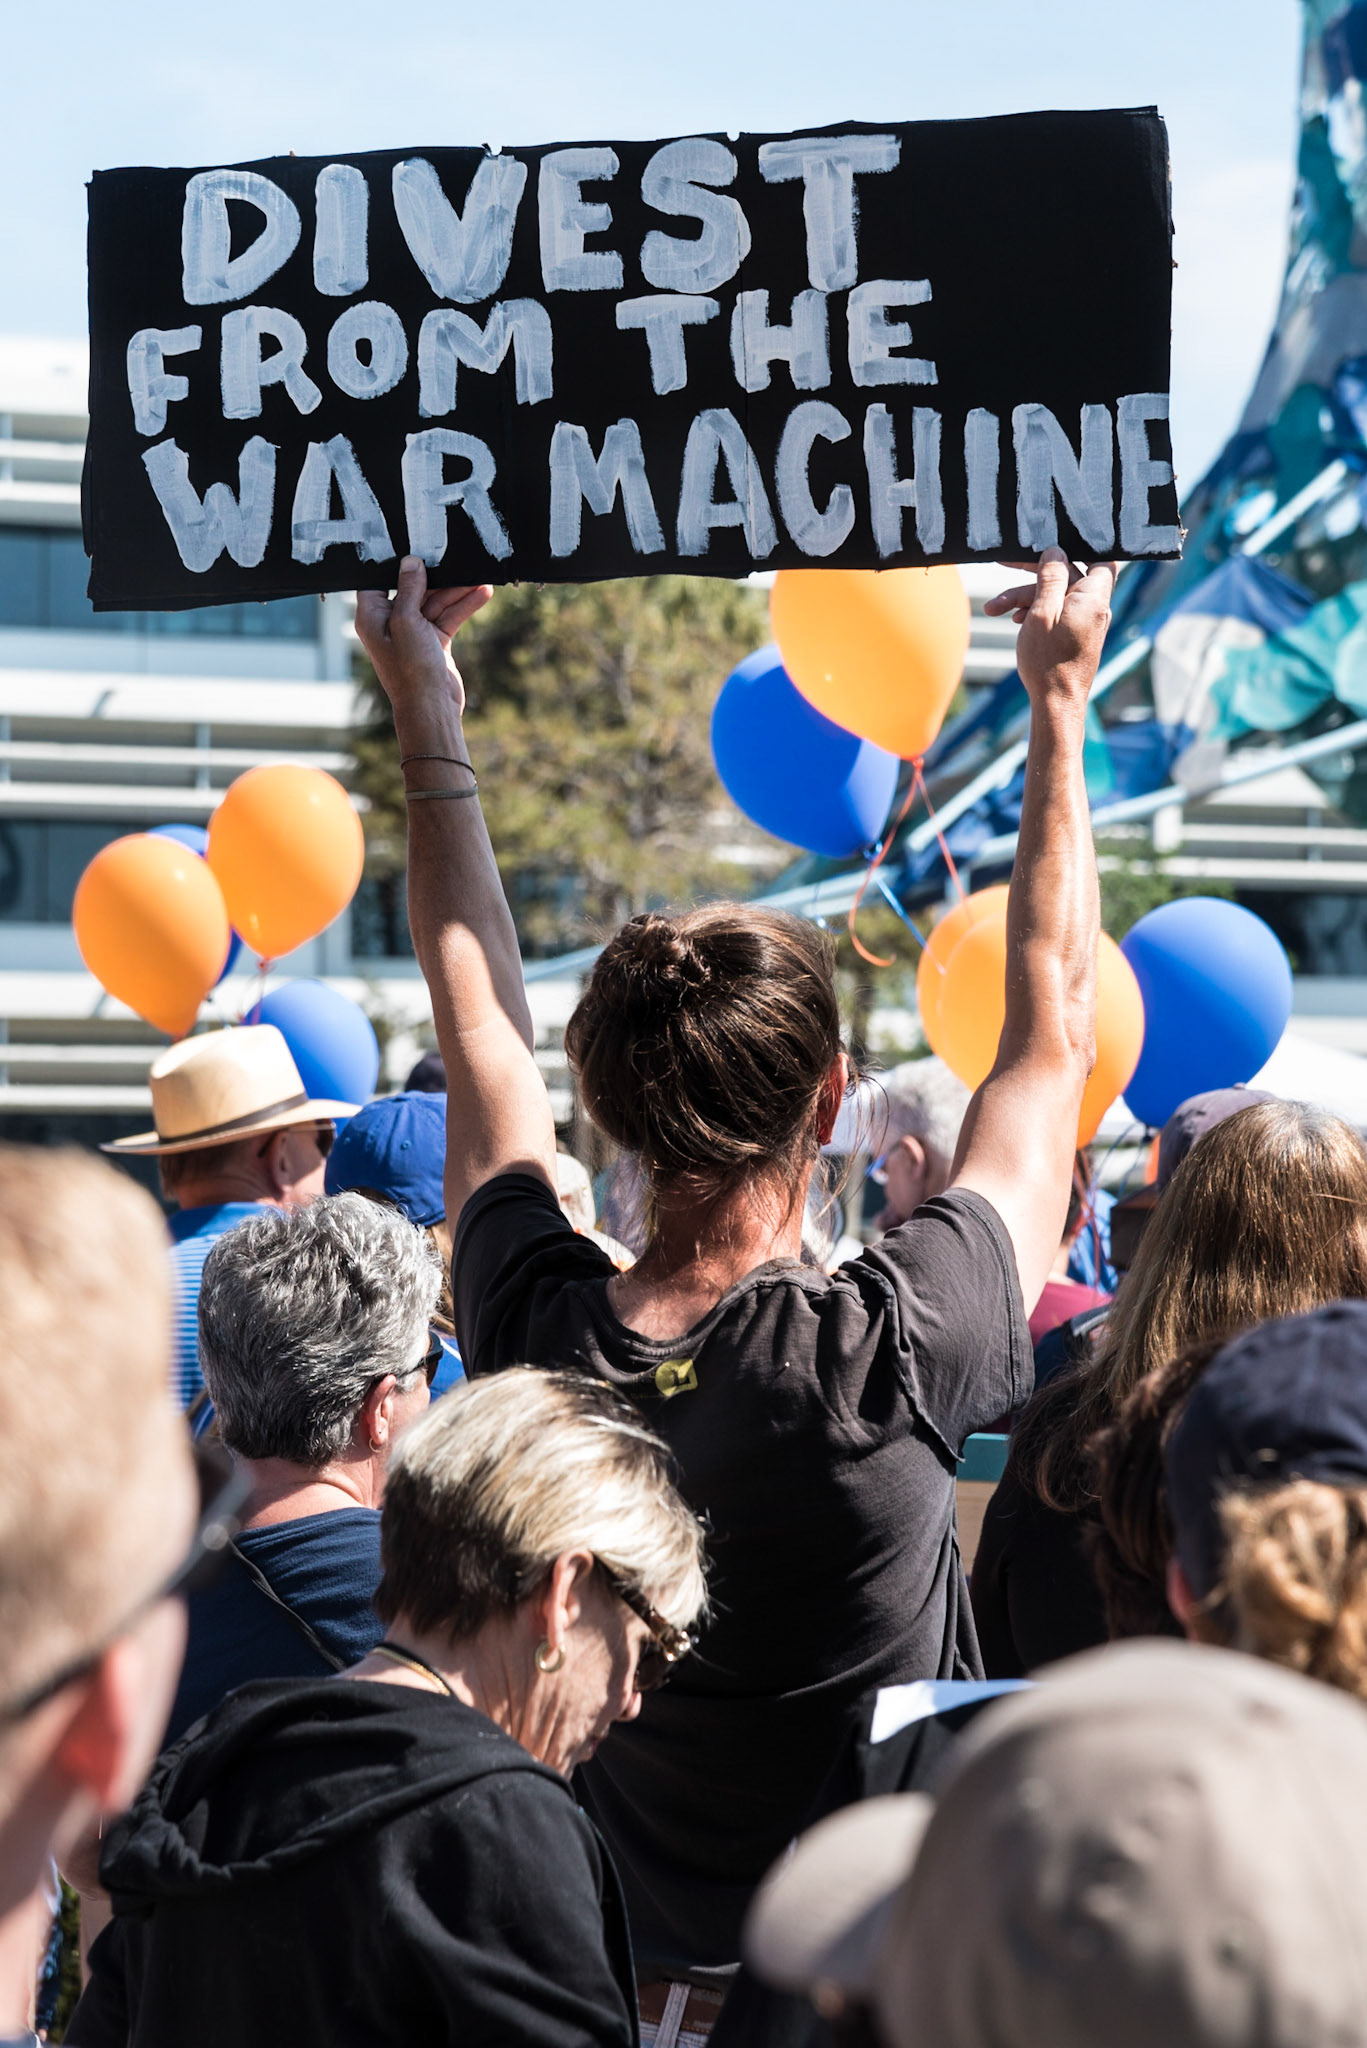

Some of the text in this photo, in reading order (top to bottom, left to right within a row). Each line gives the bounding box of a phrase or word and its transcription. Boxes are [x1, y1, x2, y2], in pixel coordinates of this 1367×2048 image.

[181, 134, 902, 305] DIVEST
[127, 278, 939, 436] FROM THE
[141, 393, 1181, 574] WAR MACHINE
